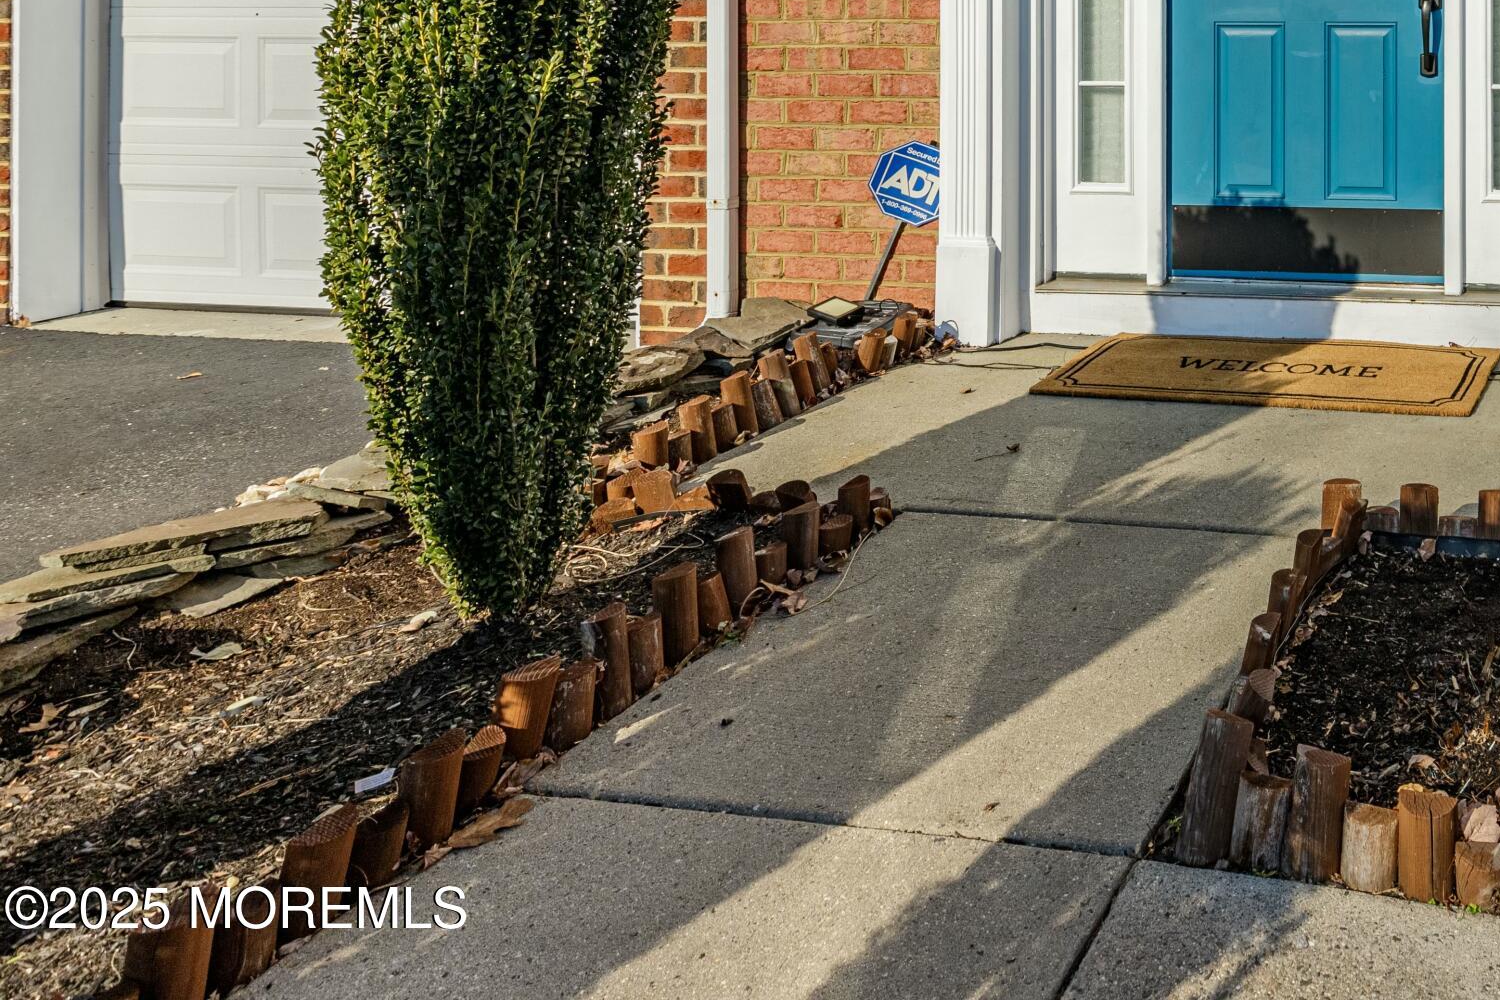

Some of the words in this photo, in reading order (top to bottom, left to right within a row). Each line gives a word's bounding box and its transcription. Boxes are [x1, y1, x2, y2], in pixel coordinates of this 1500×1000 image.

[906, 147, 938, 163] Secured
[880, 165, 940, 206] ADT
[1179, 356, 1383, 378] WELCOME
